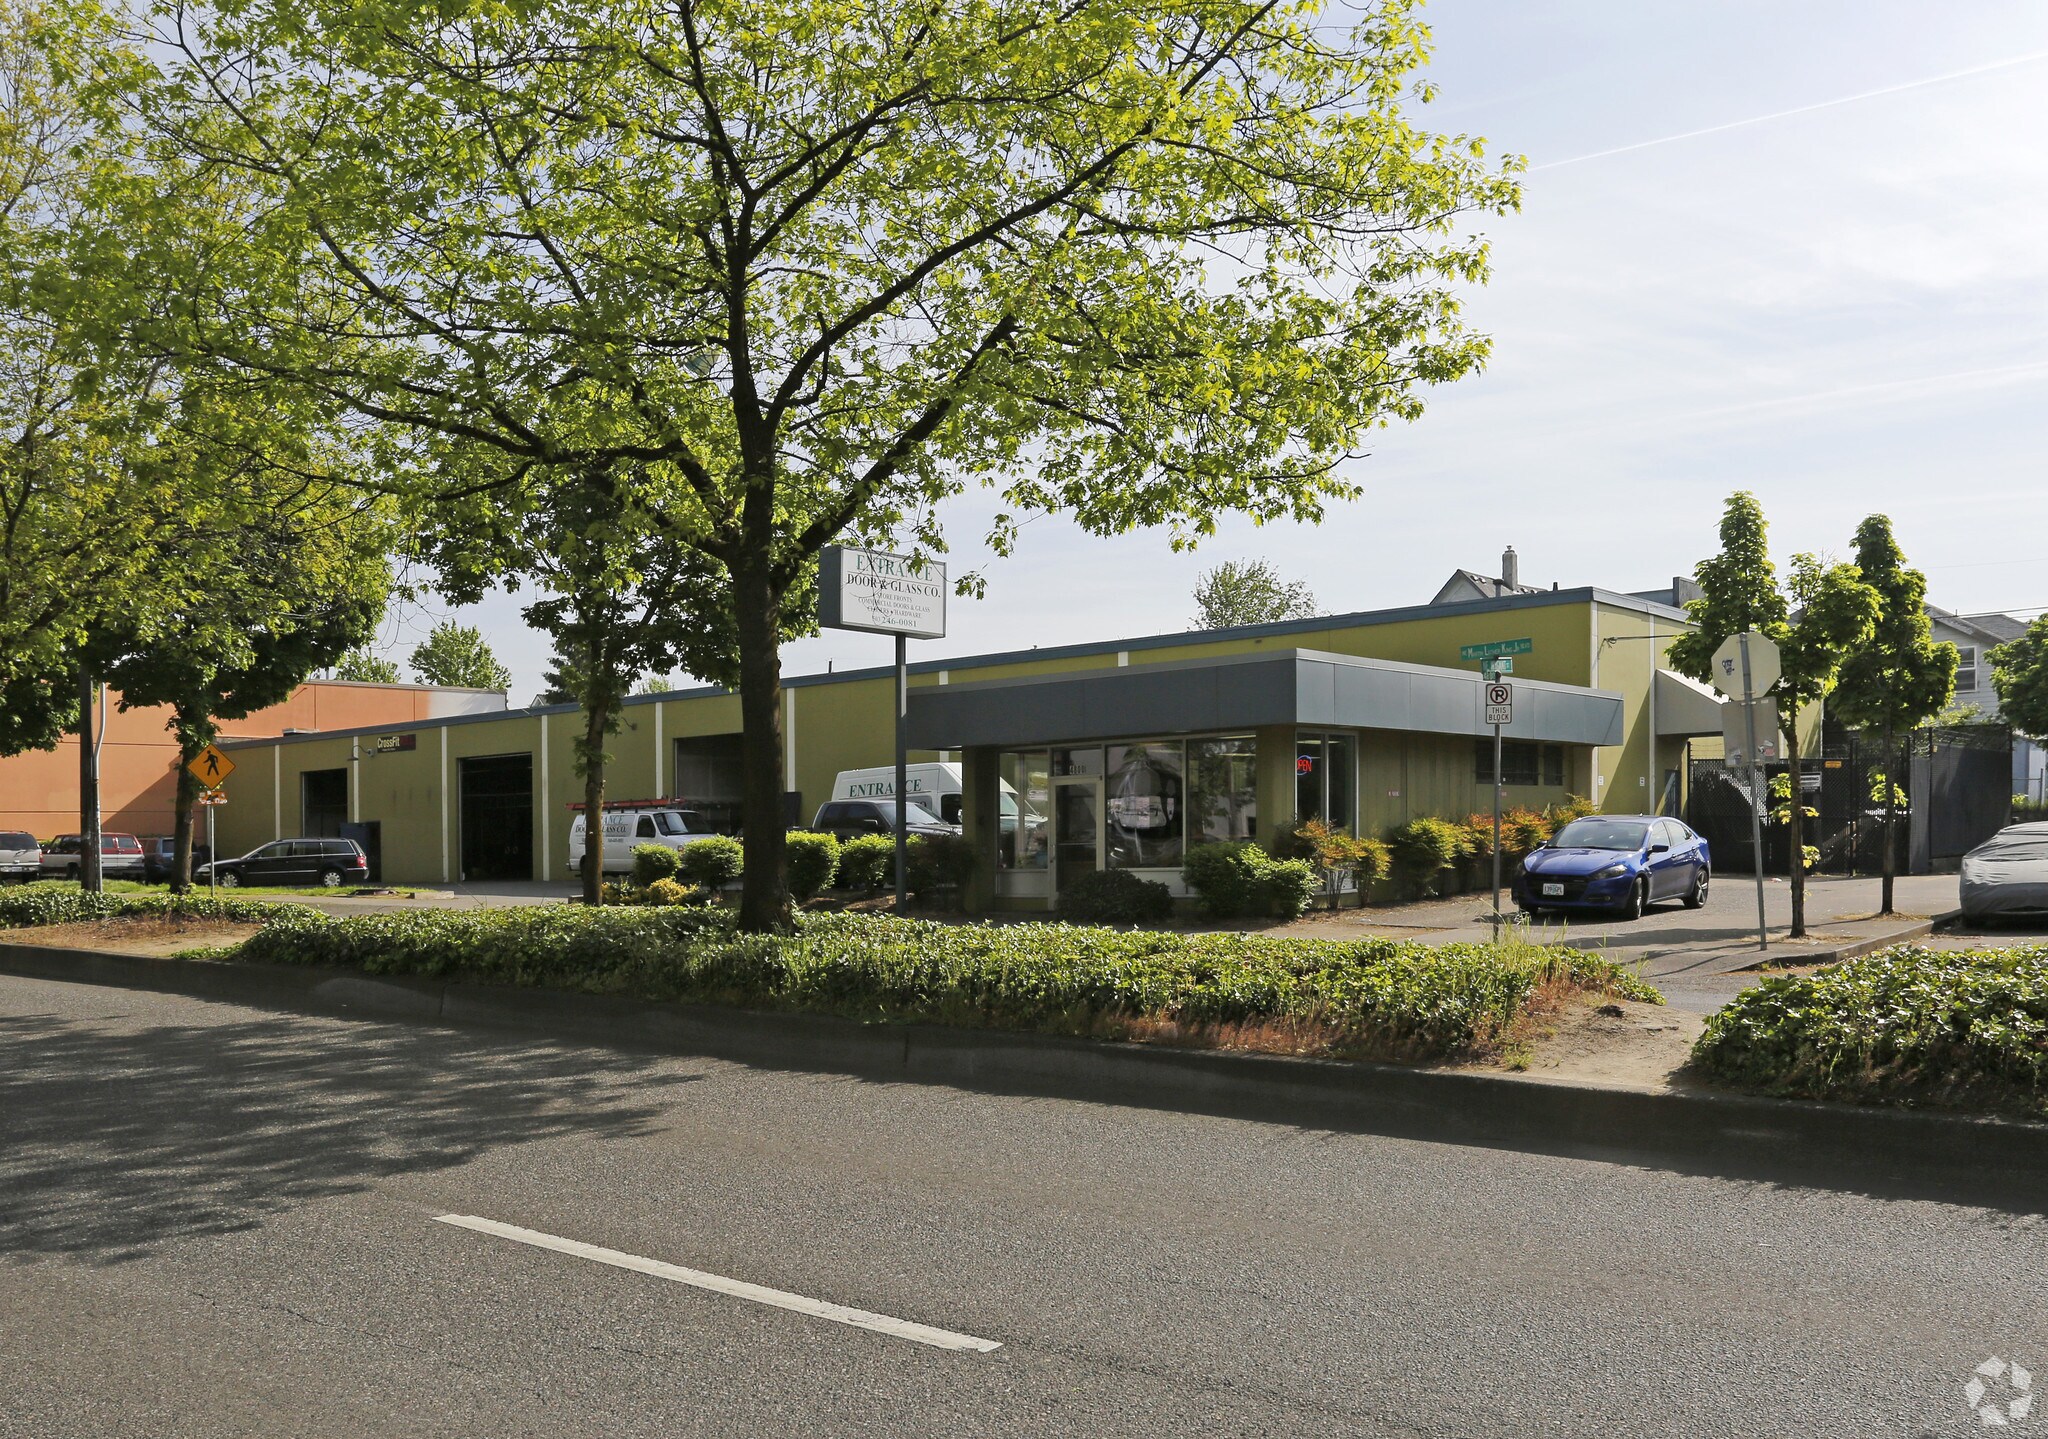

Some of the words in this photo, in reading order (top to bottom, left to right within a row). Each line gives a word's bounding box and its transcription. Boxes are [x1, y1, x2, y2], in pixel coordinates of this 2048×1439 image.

[856, 554, 933, 582] ETRANCE
[847, 573, 877, 588] DOOR
[880, 578, 888, 590] &
[890, 580, 922, 594] GLASS
[924, 585, 941, 598] CO.
[858, 597, 892, 607] COMMRCIAL
[892, 601, 910, 610] DOORS
[914, 605, 931, 613] GLASS
[893, 594, 913, 603] FRONTS
[894, 609, 921, 619] HARDWARE
[882, 616, 917, 627] 246-0081
[377, 736, 400, 749] CrossFit
[1296, 759, 1312, 772] PEN
[849, 778, 922, 798] ENTRACE
